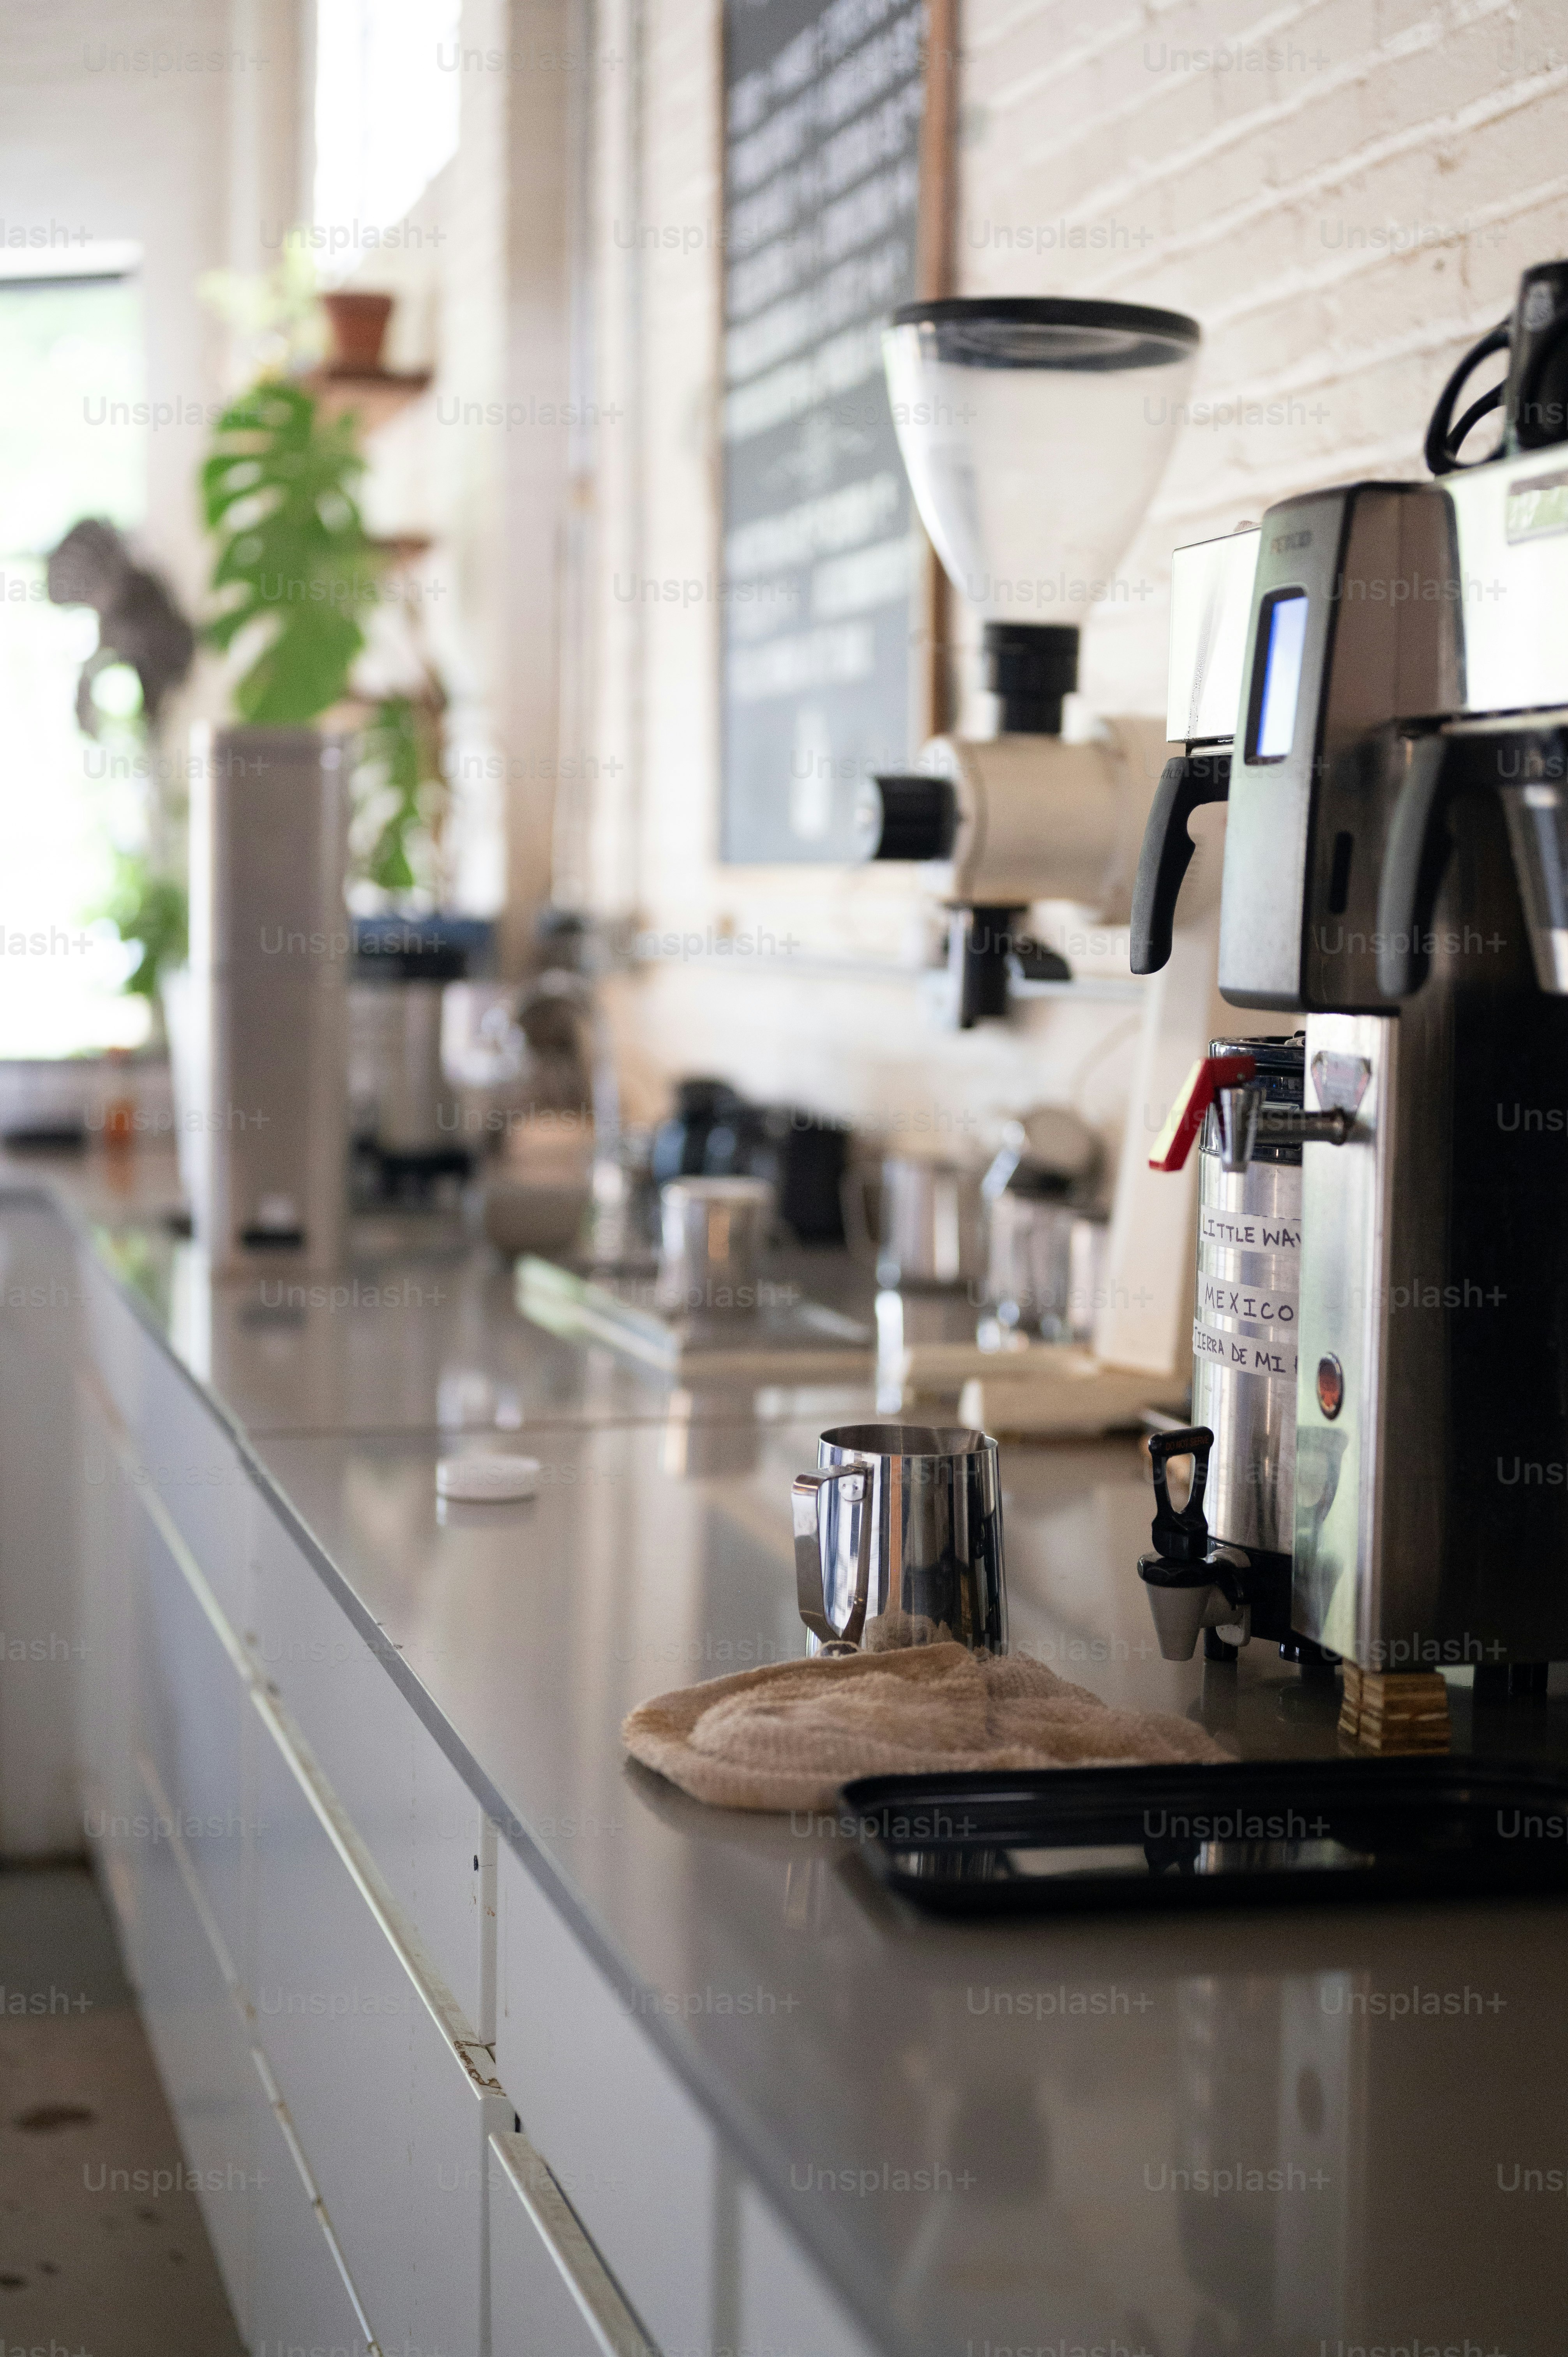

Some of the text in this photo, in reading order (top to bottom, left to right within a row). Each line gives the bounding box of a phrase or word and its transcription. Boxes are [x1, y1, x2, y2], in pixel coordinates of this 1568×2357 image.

[1203, 1214, 1255, 1243] LITTLE
[1205, 1282, 1294, 1321] MEXICO
[1195, 1327, 1224, 1355] TIERRA
[1232, 1343, 1247, 1364] DE
[1255, 1351, 1285, 1373] MI
